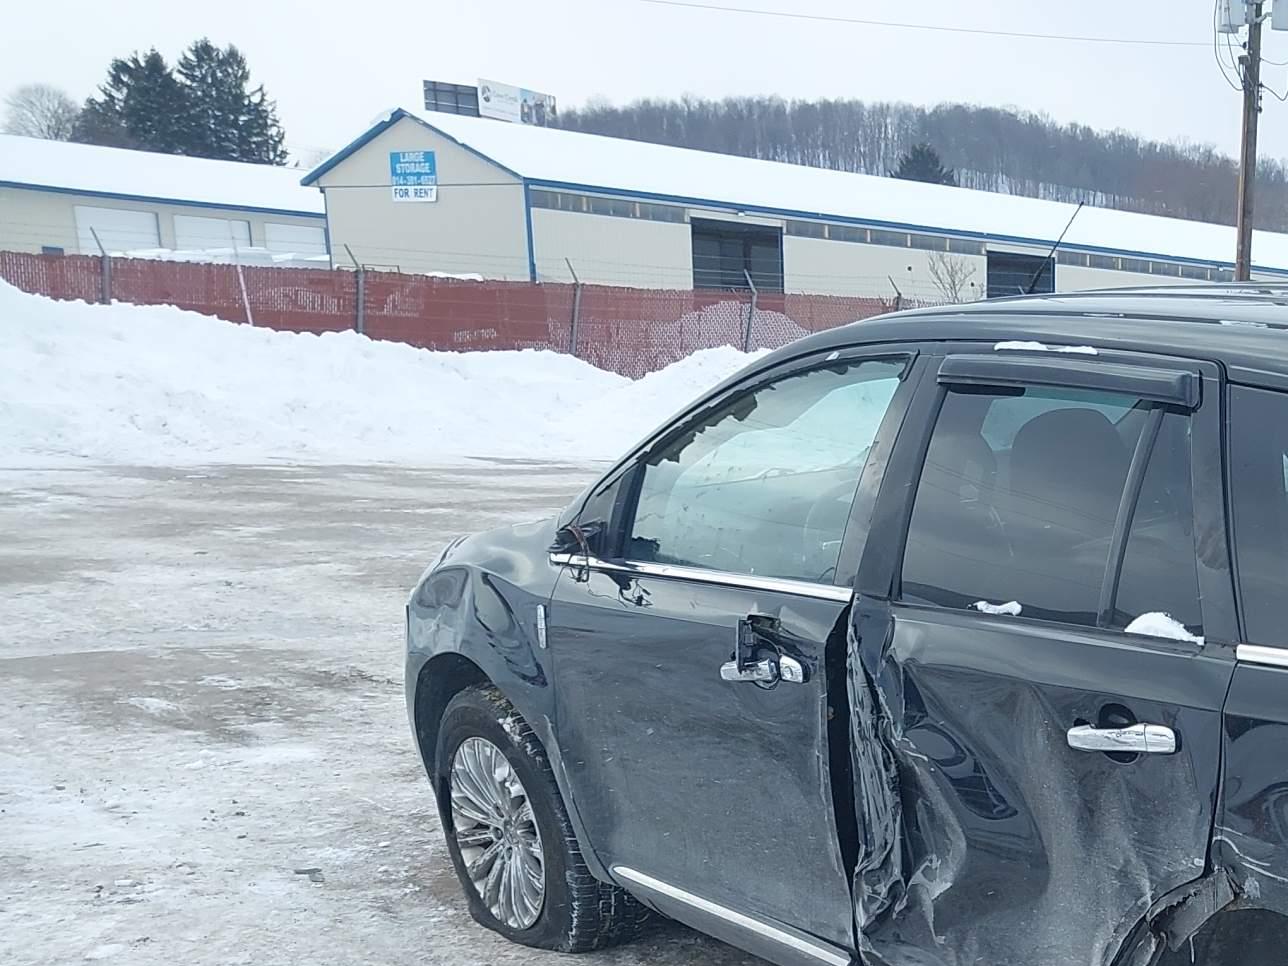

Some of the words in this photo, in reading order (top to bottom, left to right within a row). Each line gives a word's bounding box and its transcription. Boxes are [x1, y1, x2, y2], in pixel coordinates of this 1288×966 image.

[399, 152, 425, 162] LARGE
[395, 162, 432, 174] STORAGE
[393, 188, 410, 199] FOR
[413, 188, 435, 198] RENT
